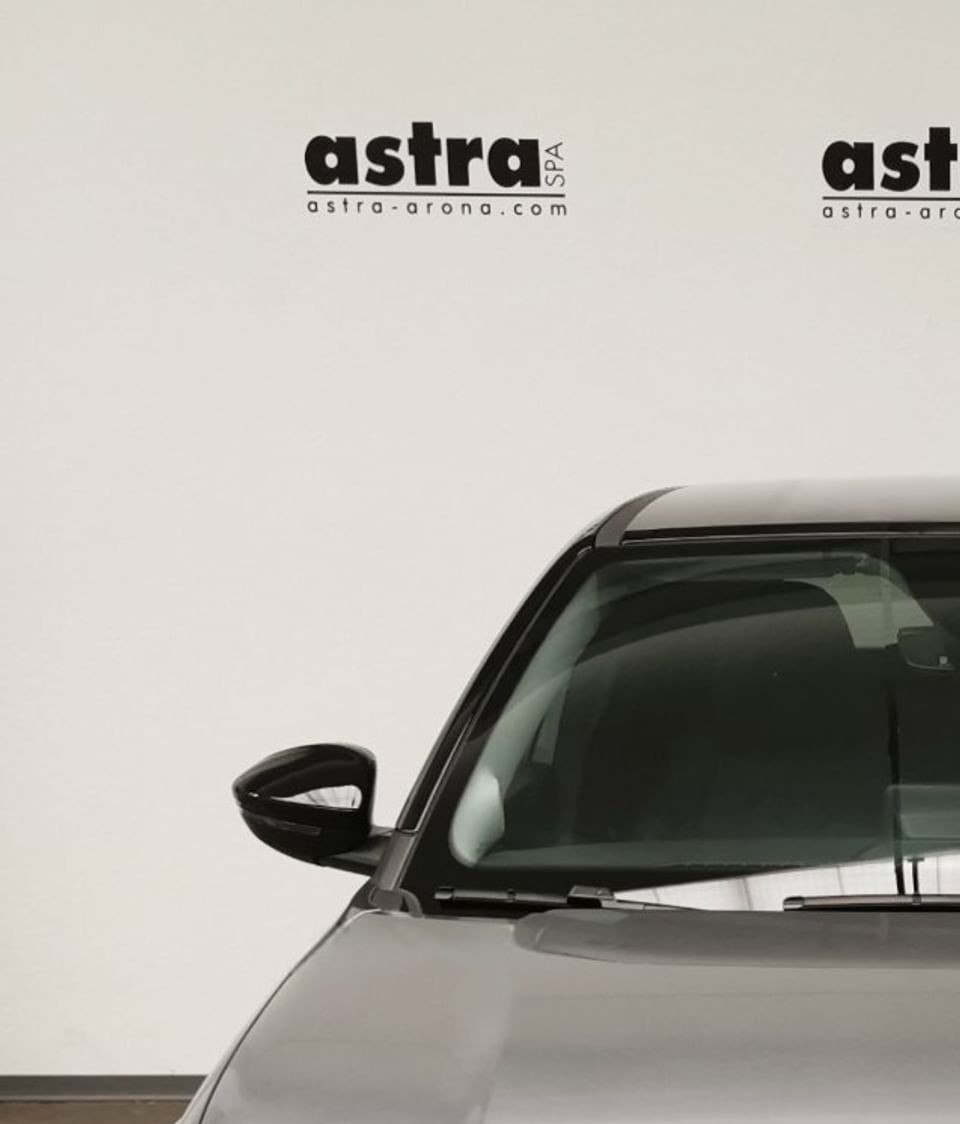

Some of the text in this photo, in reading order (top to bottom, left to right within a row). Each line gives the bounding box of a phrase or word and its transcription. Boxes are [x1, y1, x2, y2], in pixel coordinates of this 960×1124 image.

[304, 121, 566, 188] astra SPA
[306, 197, 567, 216] astra-arona.com
